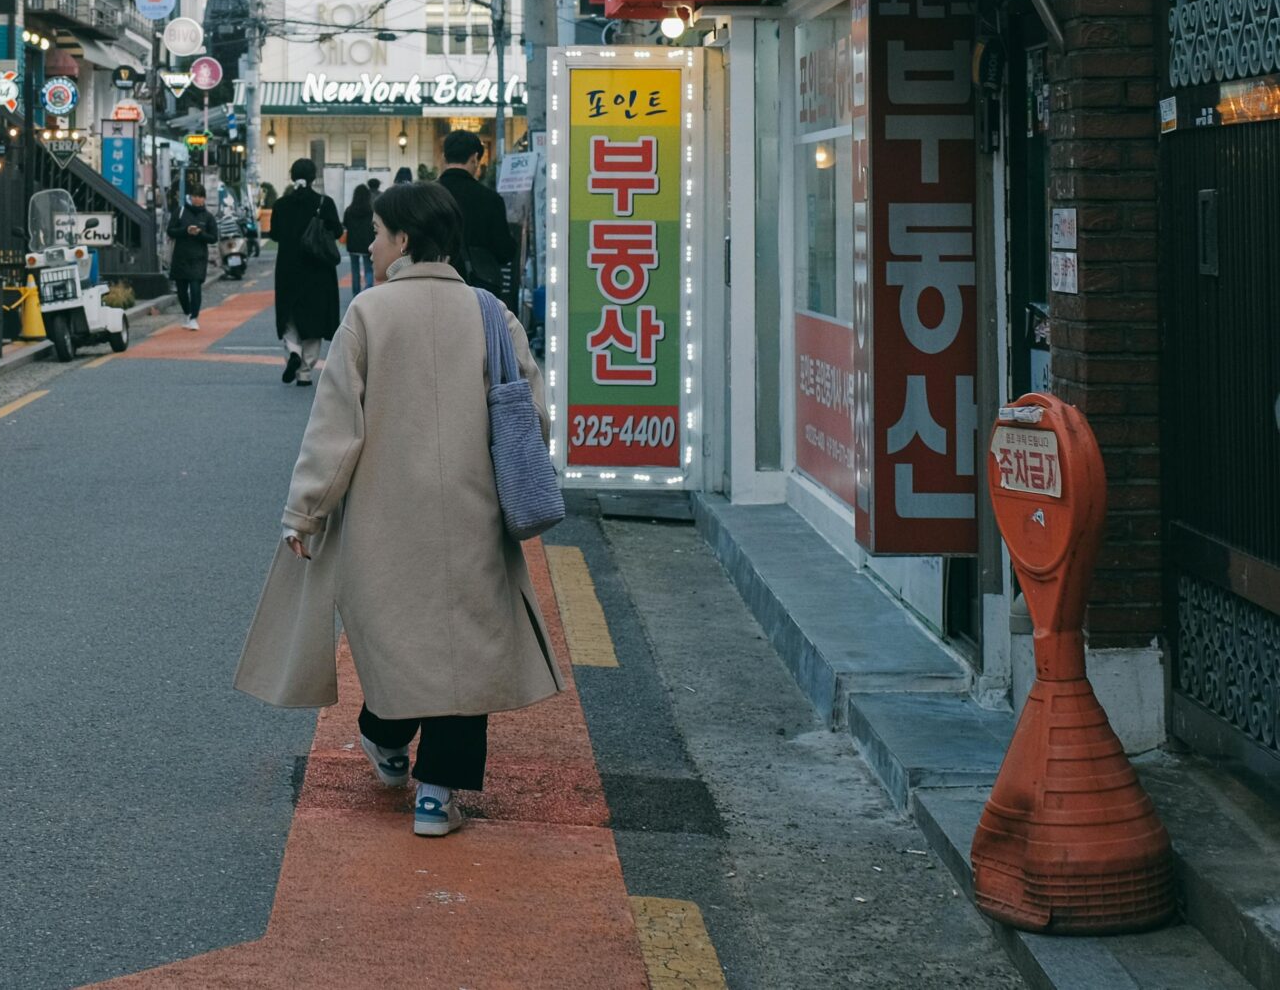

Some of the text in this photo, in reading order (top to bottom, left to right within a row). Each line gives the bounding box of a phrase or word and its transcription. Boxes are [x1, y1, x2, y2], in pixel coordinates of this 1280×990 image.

[586, 89, 668, 119] 포인트
[587, 136, 664, 386] 부동산
[884, 39, 978, 519] 부동산
[571, 415, 676, 448] 325-4400
[999, 447, 1057, 491] 주차금지
